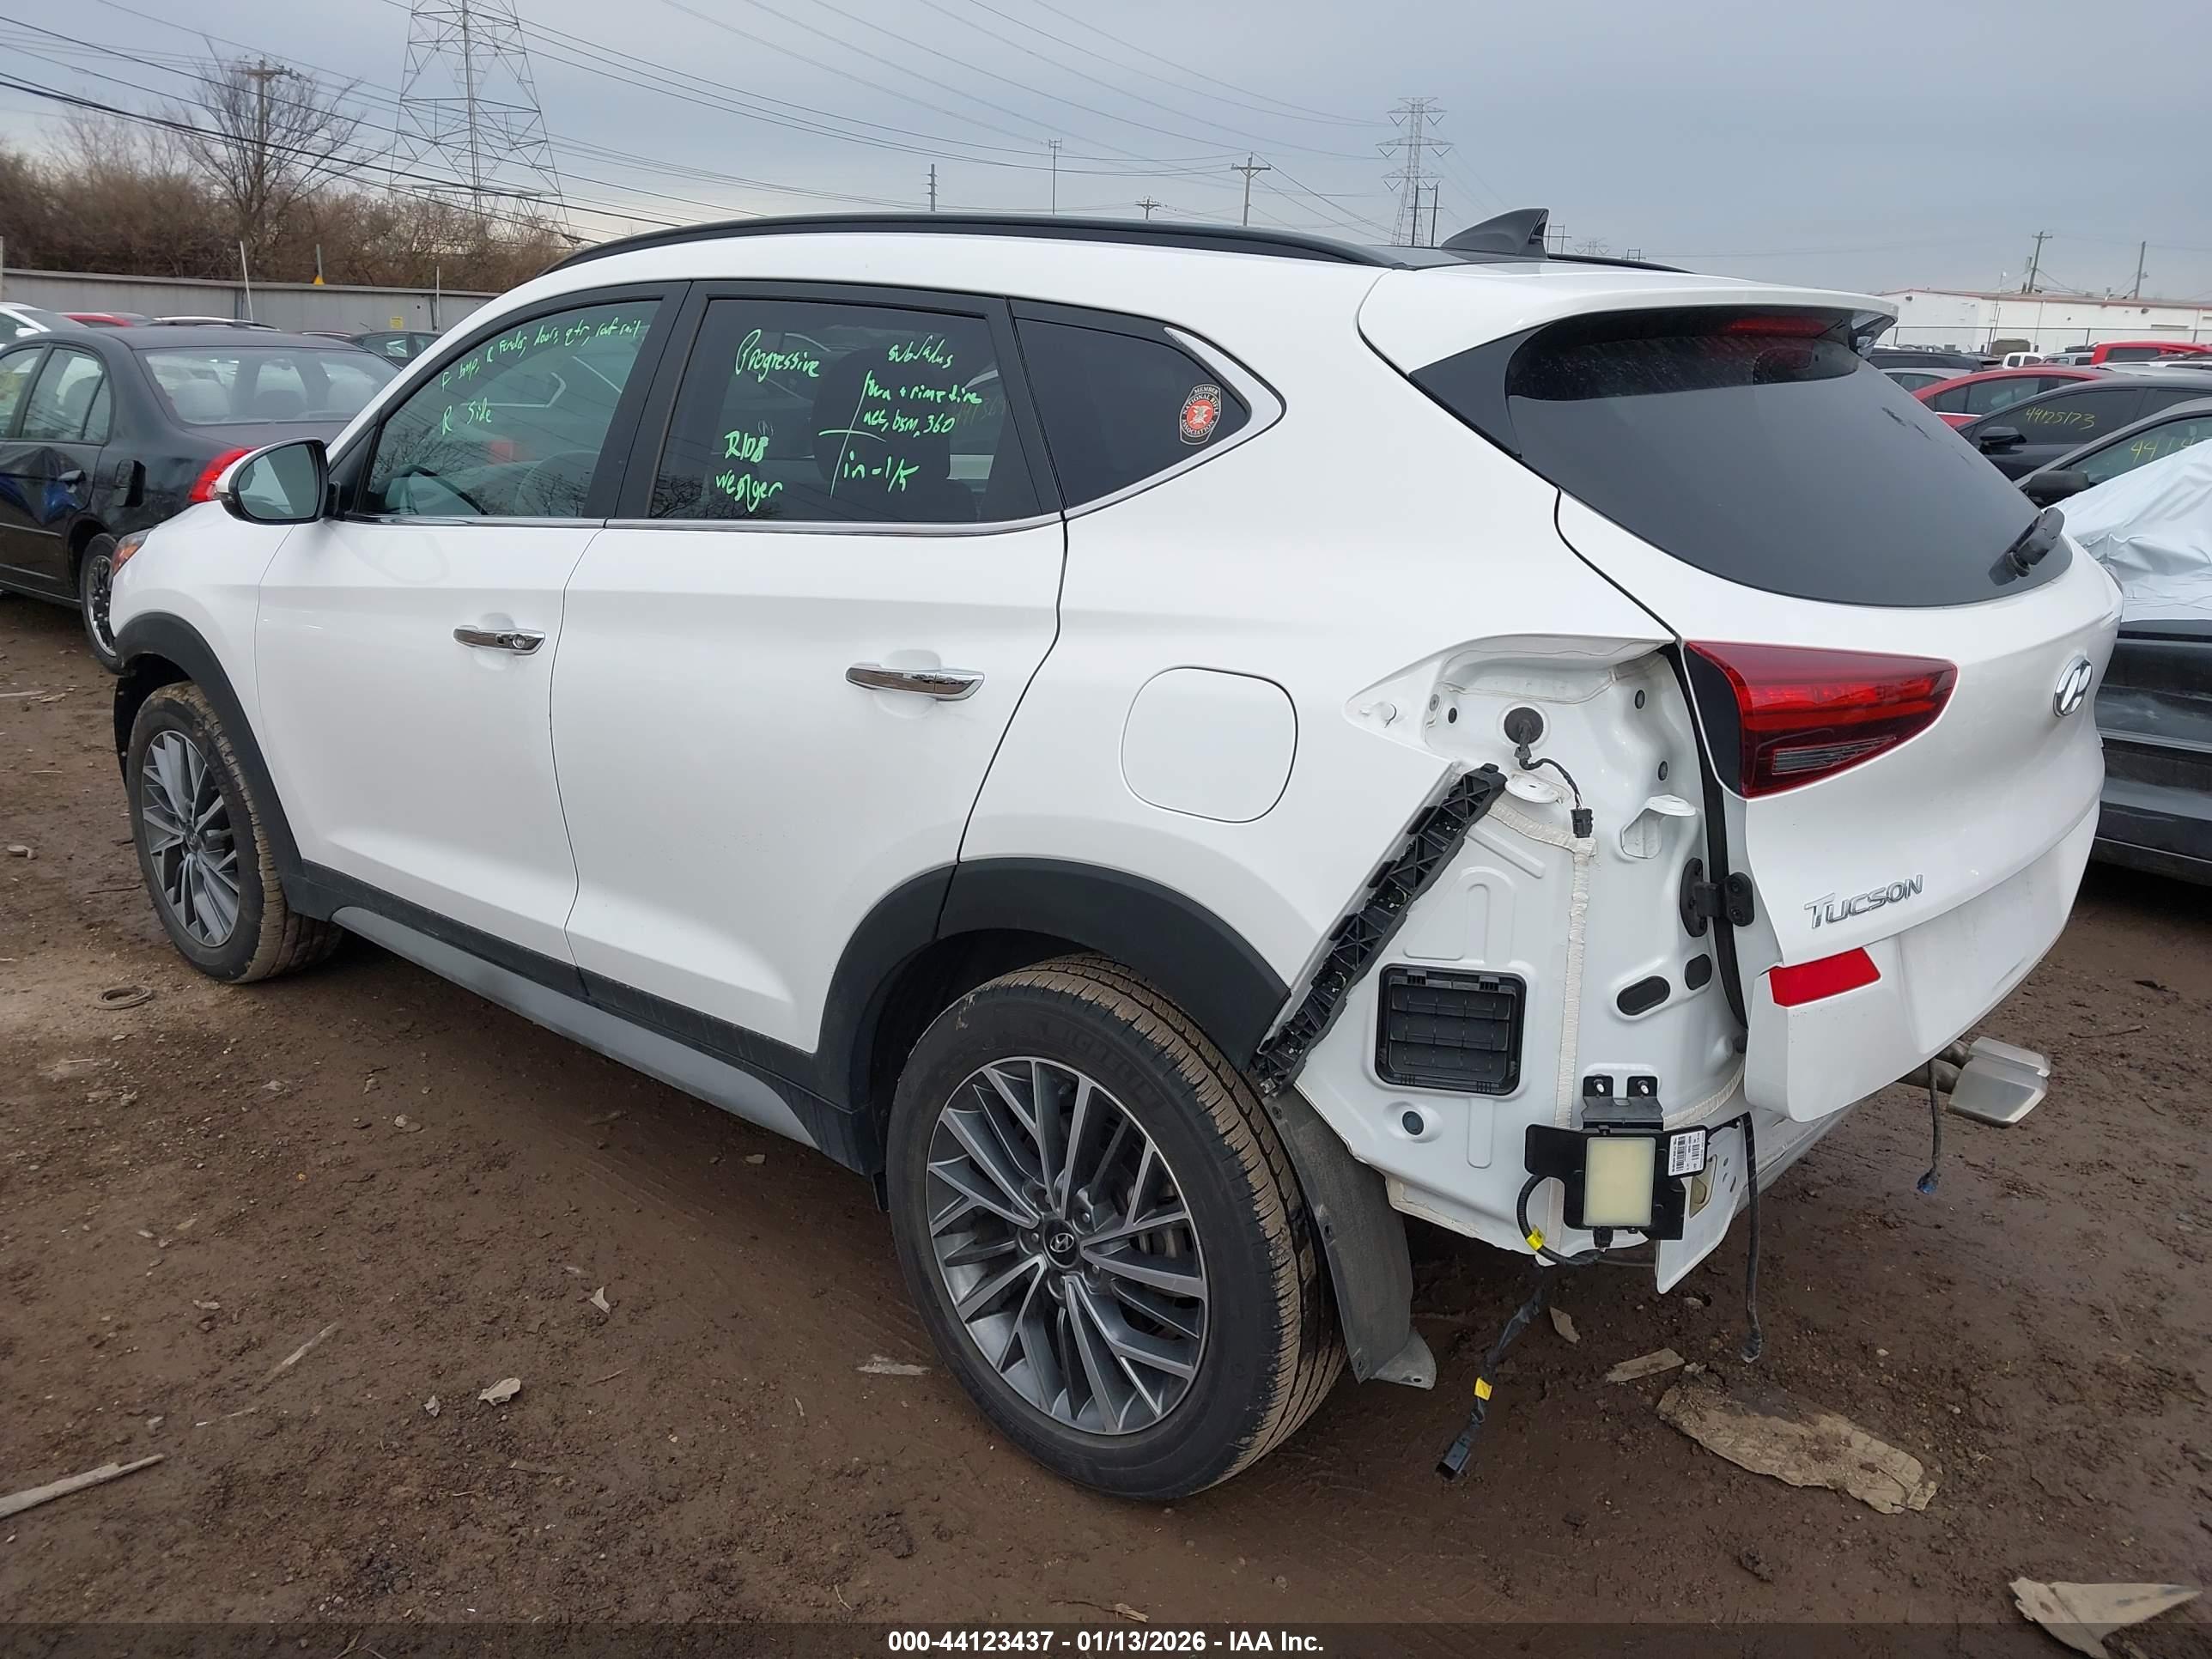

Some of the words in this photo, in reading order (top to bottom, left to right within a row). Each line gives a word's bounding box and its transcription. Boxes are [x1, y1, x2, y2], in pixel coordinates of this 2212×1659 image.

[735, 328, 820, 383] Progressive
[1194, 386, 1218, 395] MEMBER
[1182, 394, 1210, 415] NATIONAL
[1210, 397, 1219, 416] RIFLE
[441, 404, 453, 435] R
[922, 413, 956, 434] 360
[1182, 419, 1215, 435] ASSOCIATION
[1803, 874, 1923, 929] TUCSON
